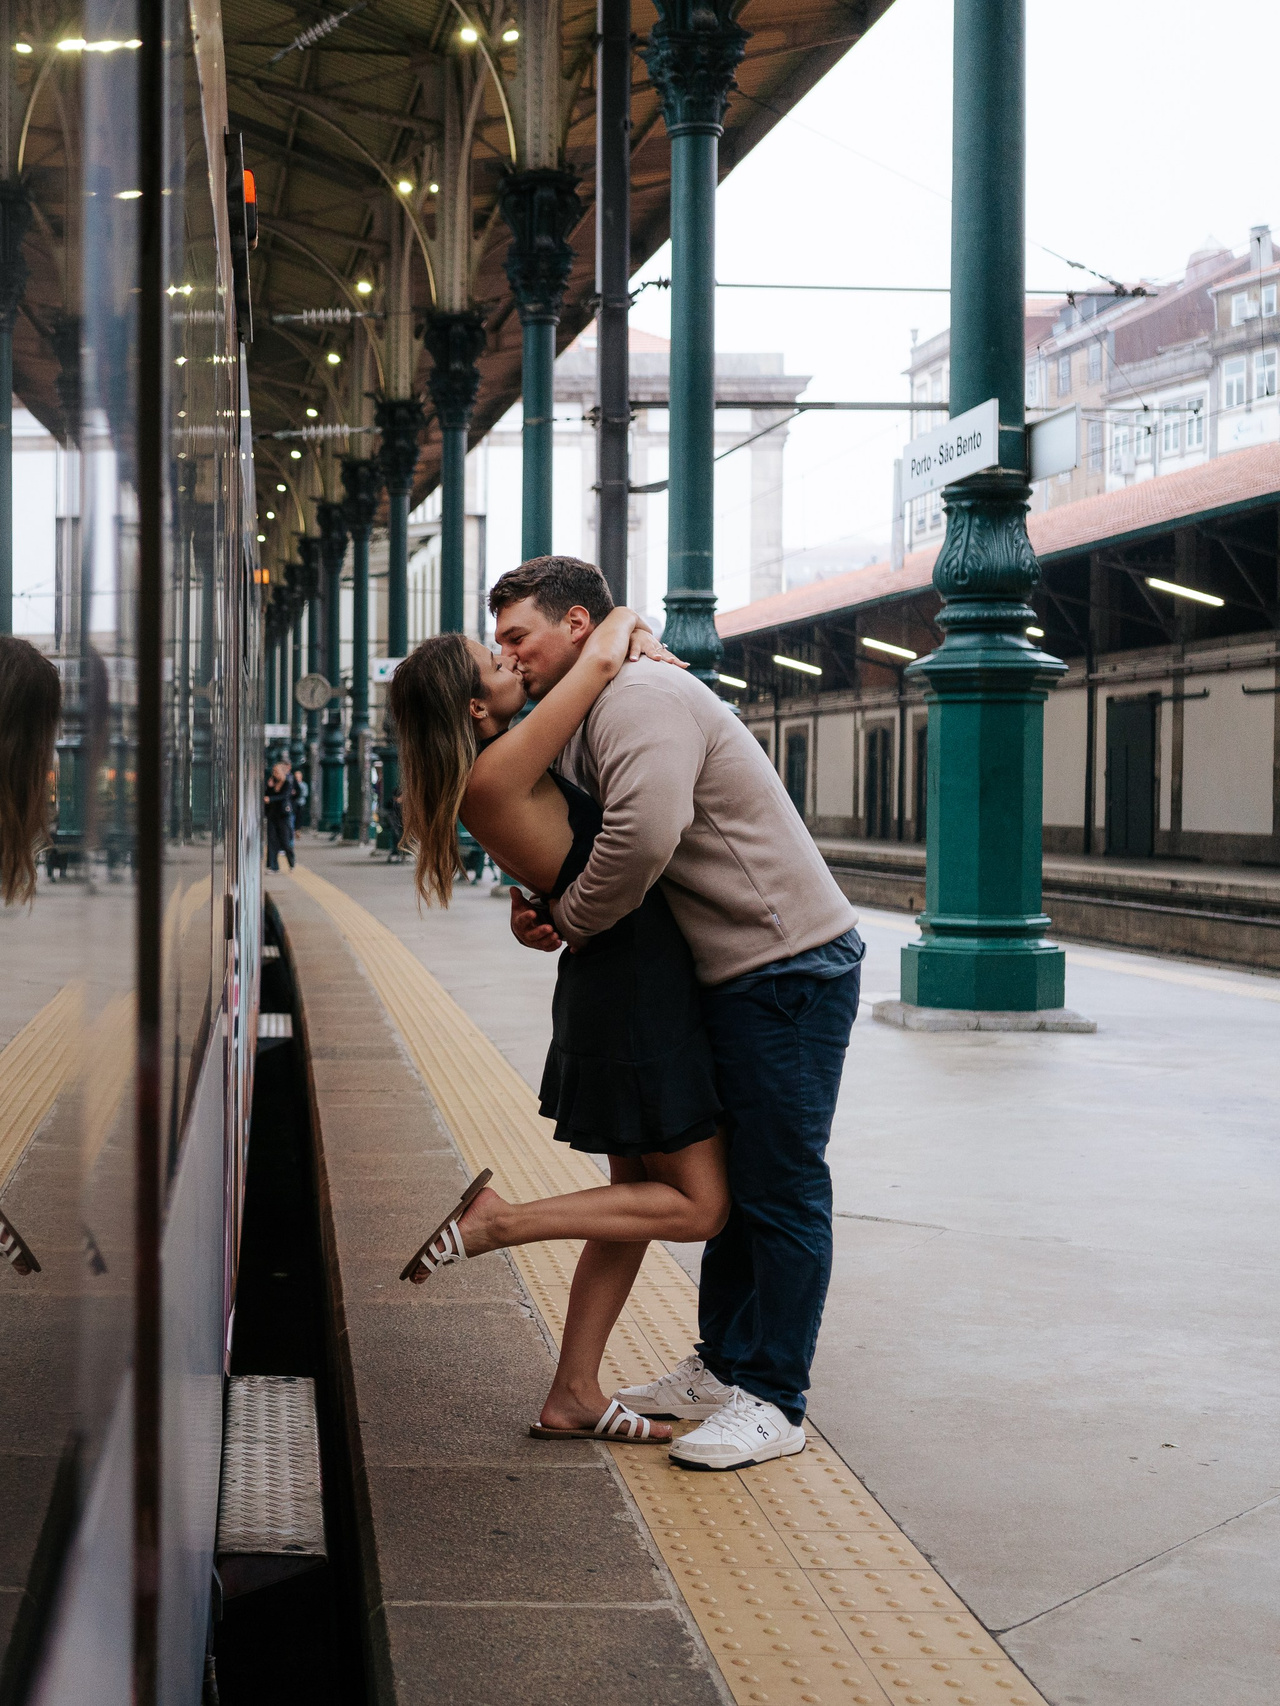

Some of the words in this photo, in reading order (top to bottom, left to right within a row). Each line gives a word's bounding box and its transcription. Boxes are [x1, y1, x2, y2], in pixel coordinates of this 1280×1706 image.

[910, 453, 932, 478] Porto
[938, 443, 954, 466] São
[956, 429, 982, 457] Bento
